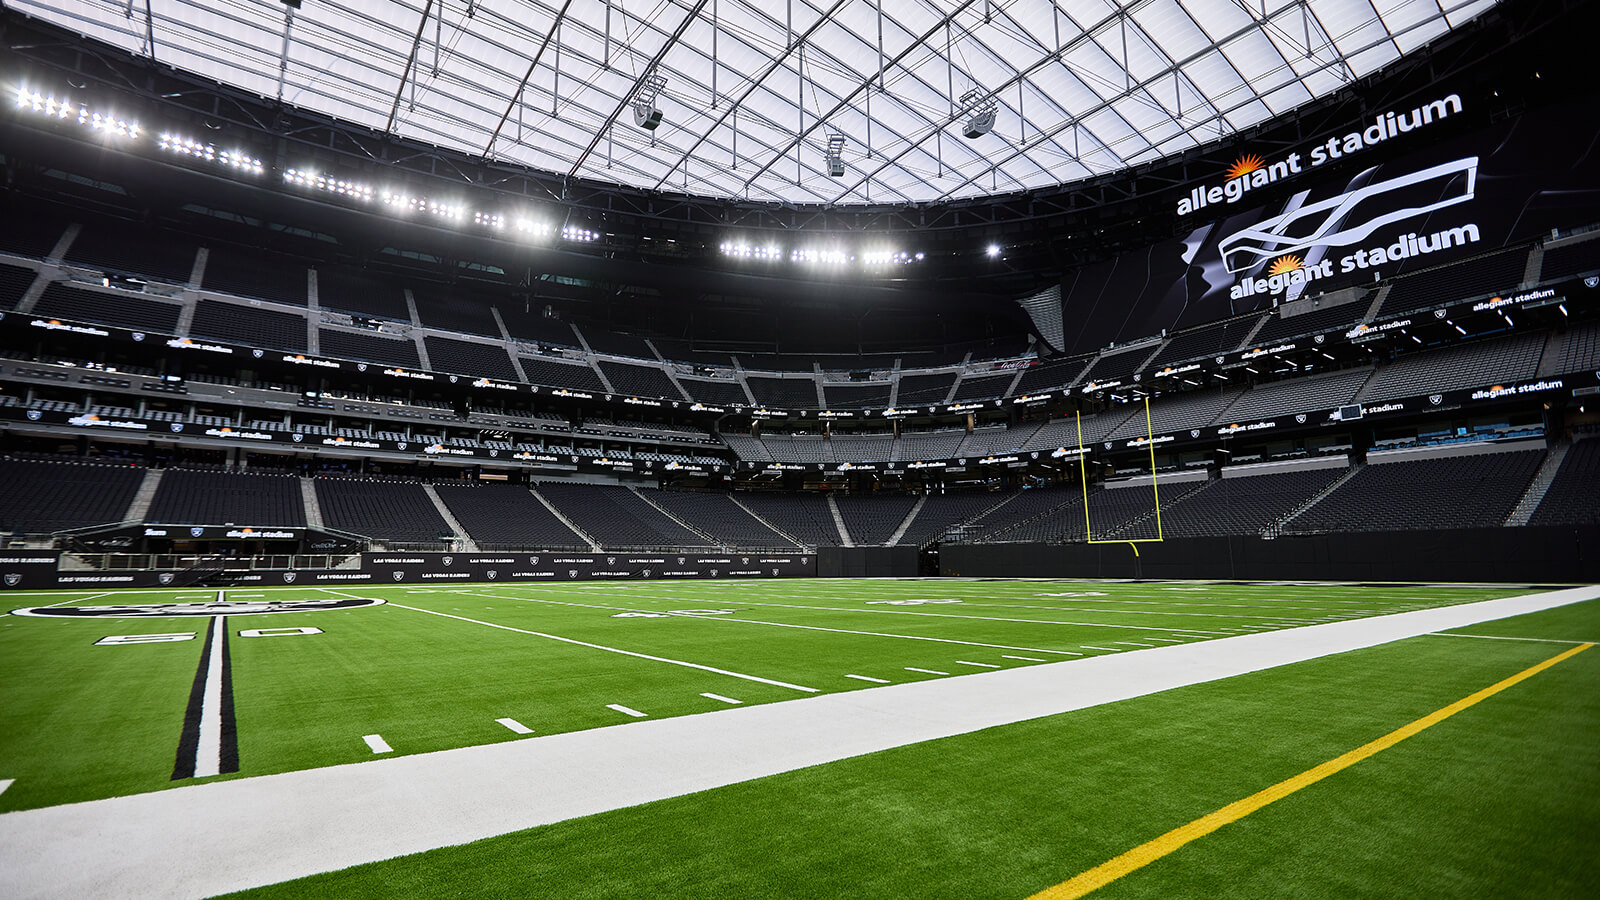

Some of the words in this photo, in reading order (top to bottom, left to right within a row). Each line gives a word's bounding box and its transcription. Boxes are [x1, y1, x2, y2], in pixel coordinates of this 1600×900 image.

[1177, 153, 1301, 216] allegiant
[1311, 94, 1462, 166] stadium
[1230, 259, 1333, 300] allegiant
[1341, 223, 1480, 274] stadium
[1473, 298, 1513, 311] allegiant
[1515, 289, 1555, 303] stadium
[1379, 320, 1411, 330] stadium
[1242, 350, 1268, 359] allegiant
[1269, 344, 1295, 353] stadium
[1472, 387, 1516, 399] allegiant
[1519, 380, 1563, 393] stadium
[1369, 404, 1403, 414] stadium
[1217, 424, 1246, 434] allegiant
[1247, 422, 1275, 430] stadium
